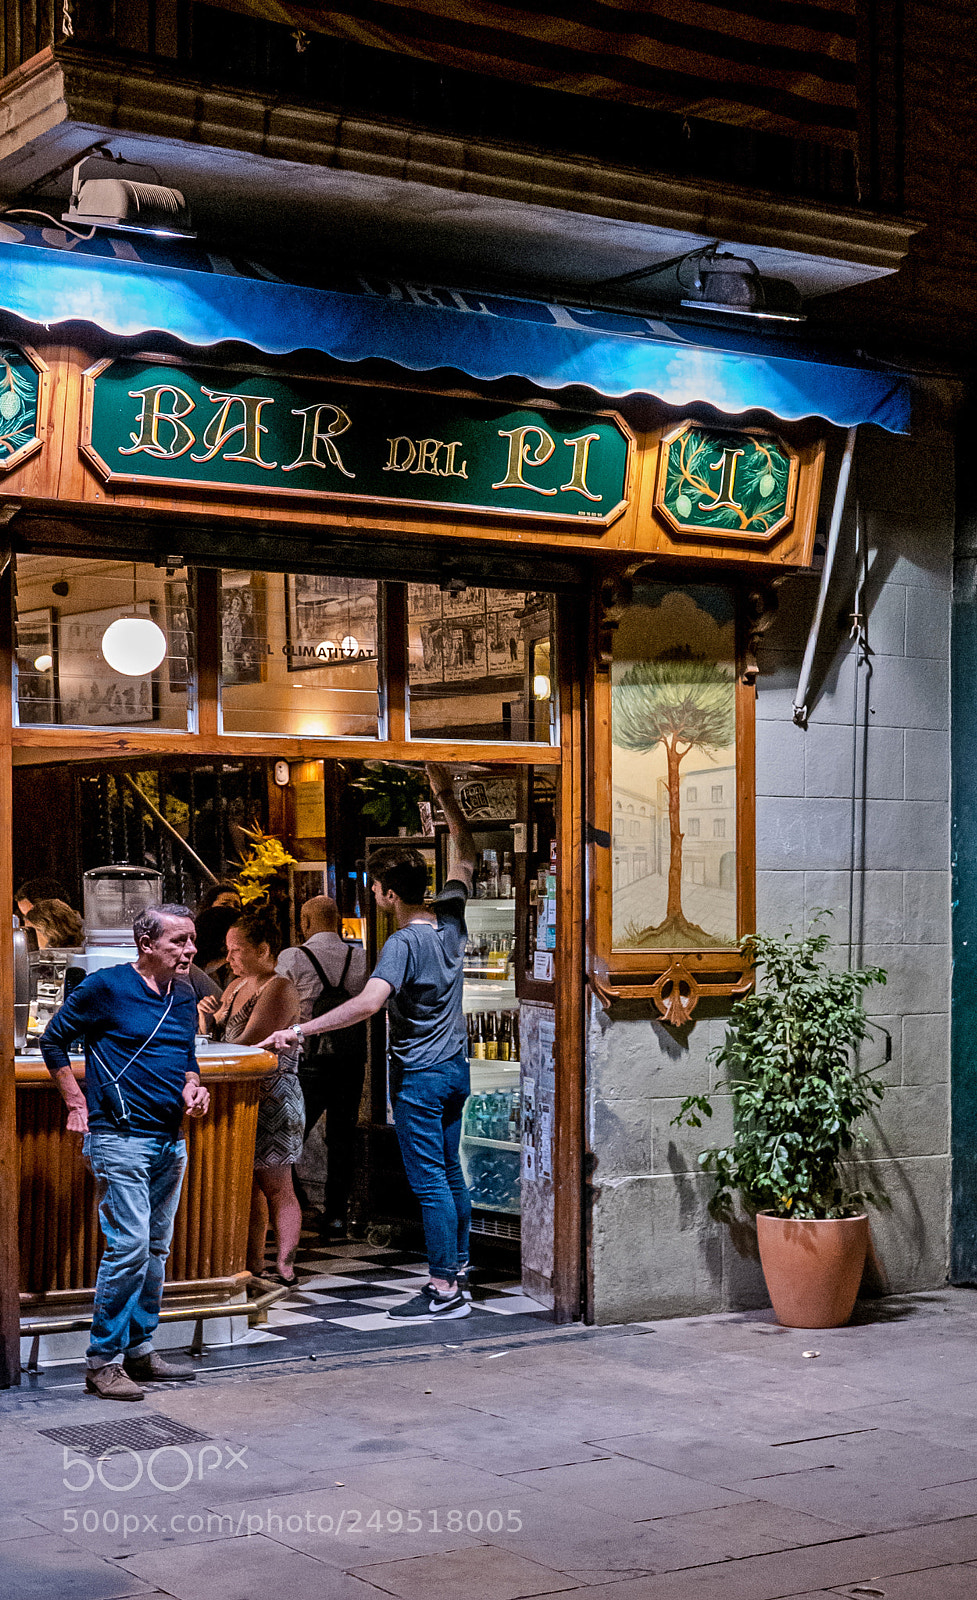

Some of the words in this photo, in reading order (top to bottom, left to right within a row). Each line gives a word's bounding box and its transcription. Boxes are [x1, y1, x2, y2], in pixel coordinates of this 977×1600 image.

[118, 384, 356, 479] BAR
[383, 436, 469, 480] DEL
[491, 425, 603, 502] PI
[281, 644, 374, 659] CLIMATITZAT
